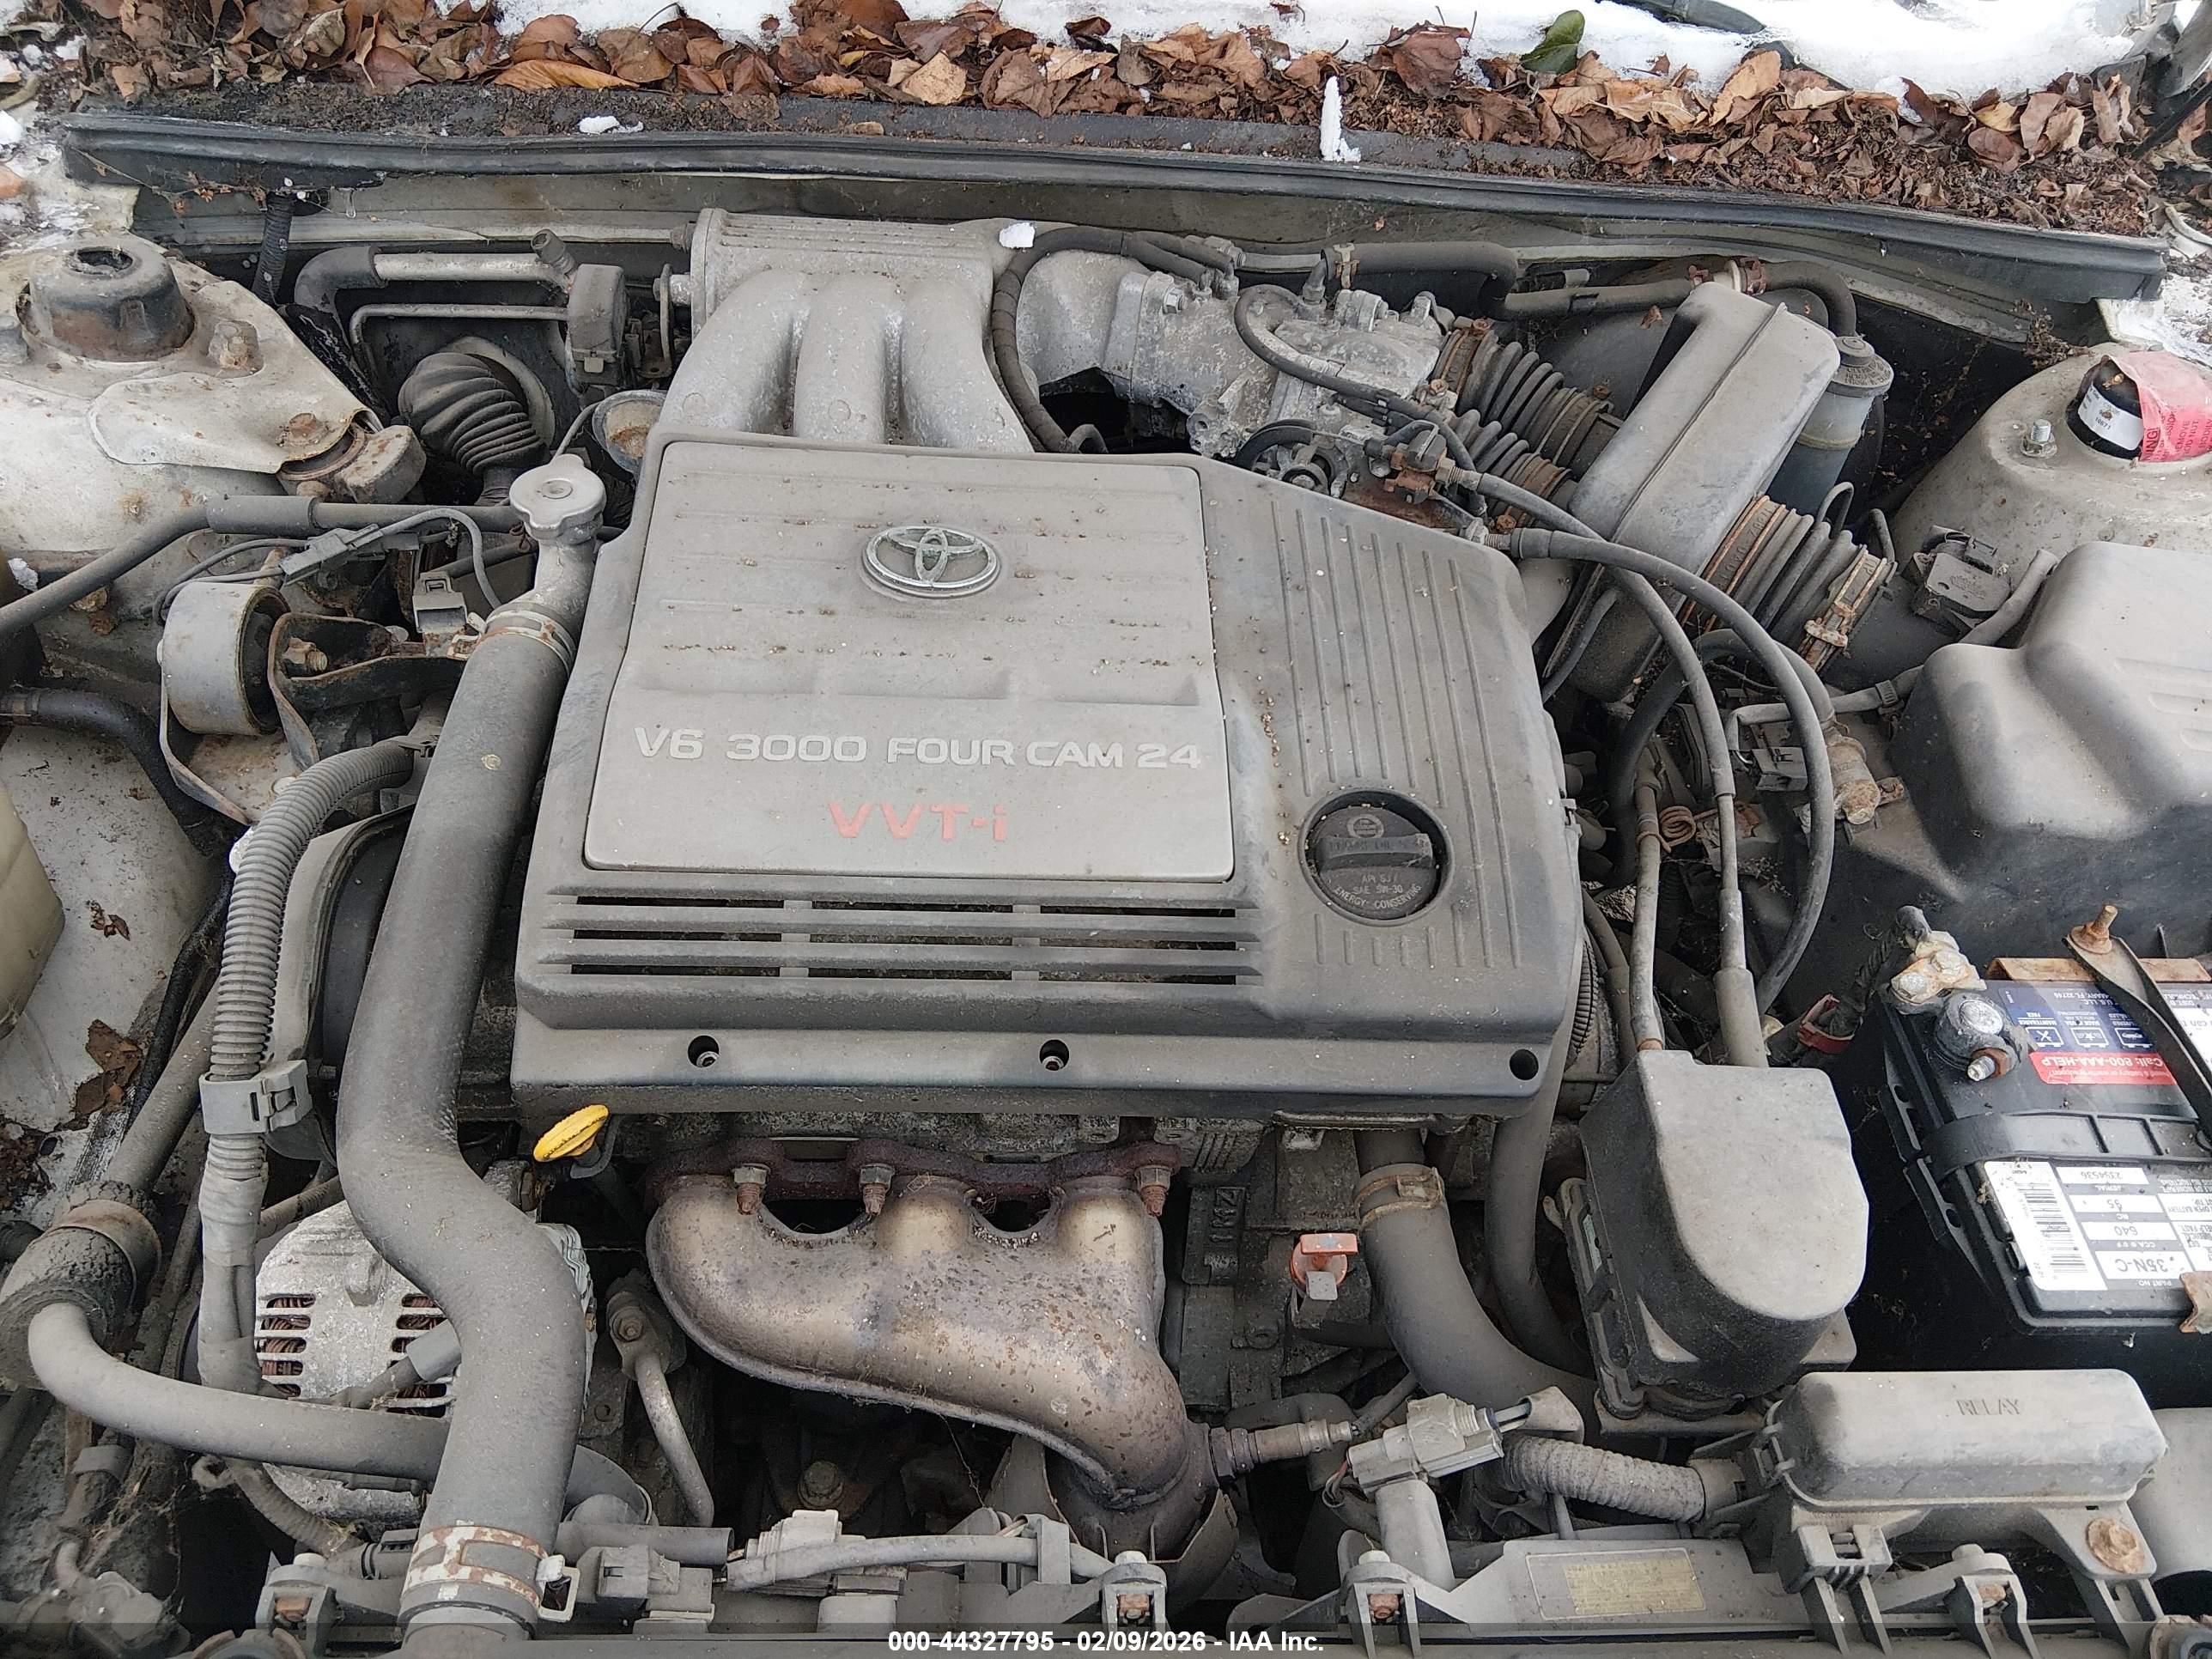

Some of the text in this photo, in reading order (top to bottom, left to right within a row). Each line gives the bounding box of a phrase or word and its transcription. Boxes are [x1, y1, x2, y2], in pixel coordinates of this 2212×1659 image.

[635, 726, 1201, 769] V6 3000 FOUR CAM 24
[827, 801, 1007, 842] VVT-i
[1374, 882, 1423, 909] CONSERVING
[2041, 1057, 2164, 1067] Call: 800-AAA-HELP
[2113, 1225, 2138, 1236] 640
[2114, 1258, 2168, 1272] 35N-C
[1956, 1398, 2021, 1416] RELAY
